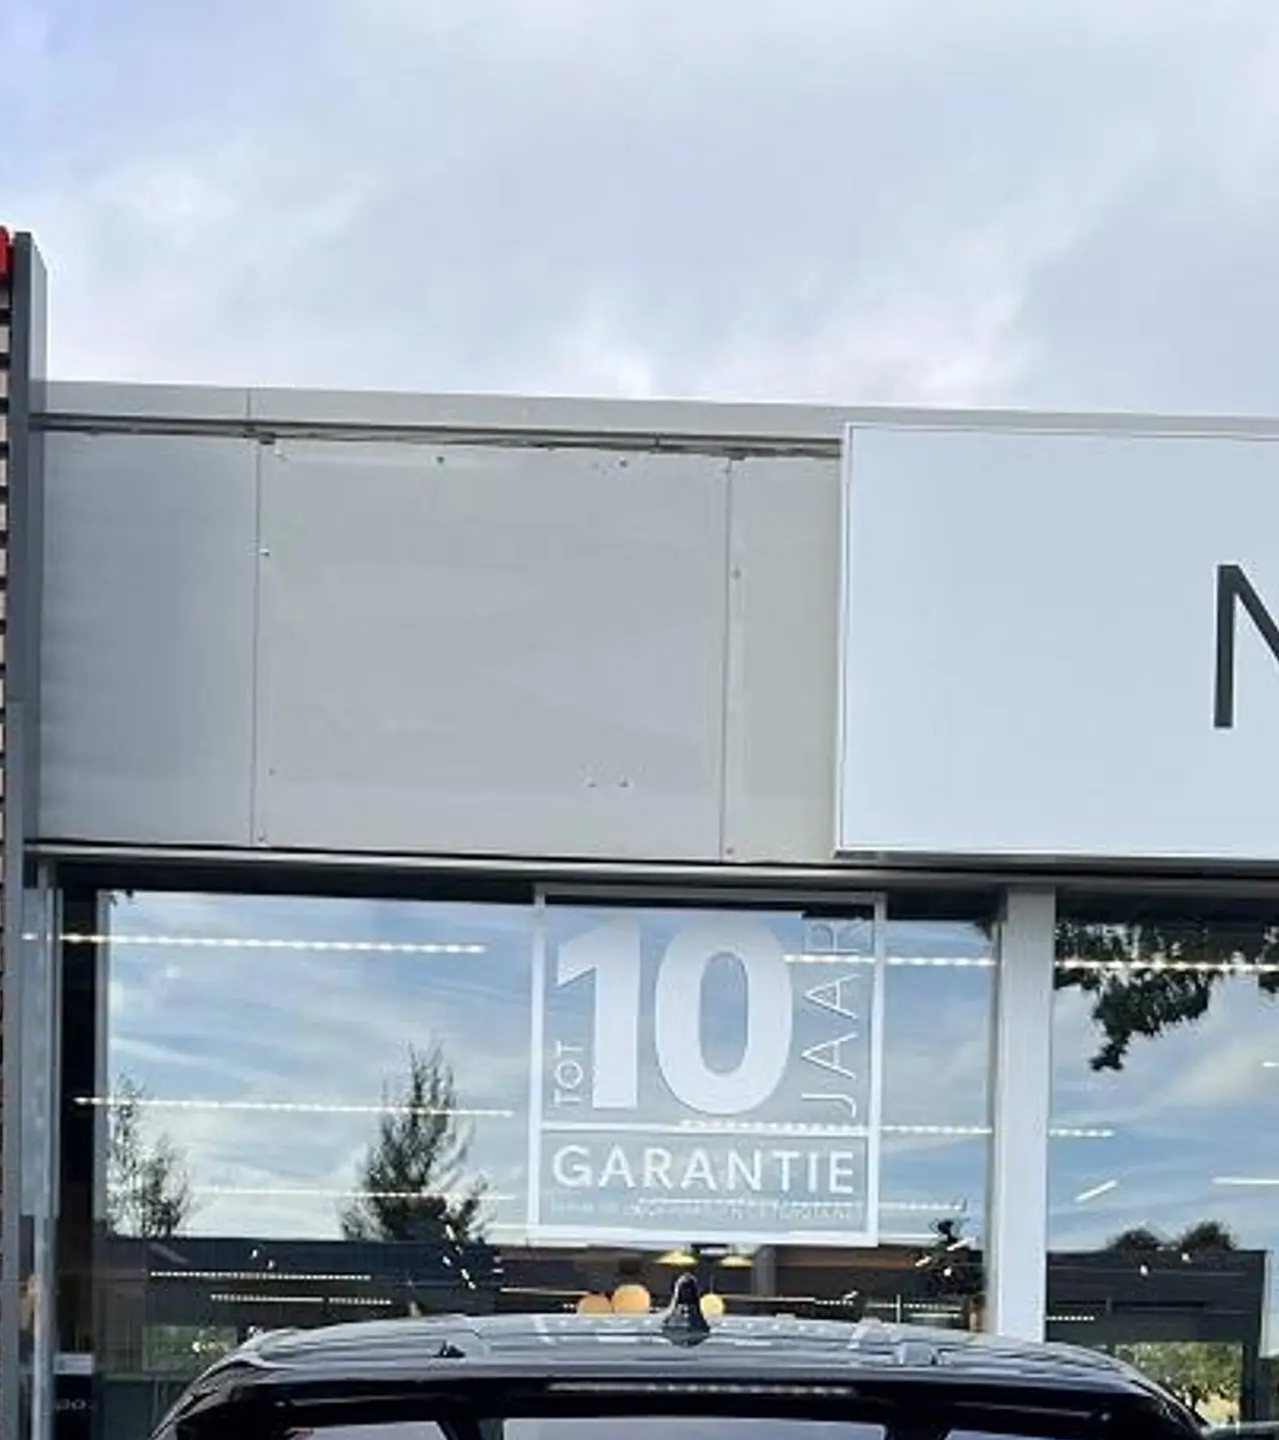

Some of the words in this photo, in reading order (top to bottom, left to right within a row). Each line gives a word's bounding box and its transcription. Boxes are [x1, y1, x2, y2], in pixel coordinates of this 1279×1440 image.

[555, 1041, 585, 1108] TOT
[557, 914, 793, 1116] 10
[800, 918, 863, 1118] JAAR
[552, 1144, 855, 1195] GARANTIE
